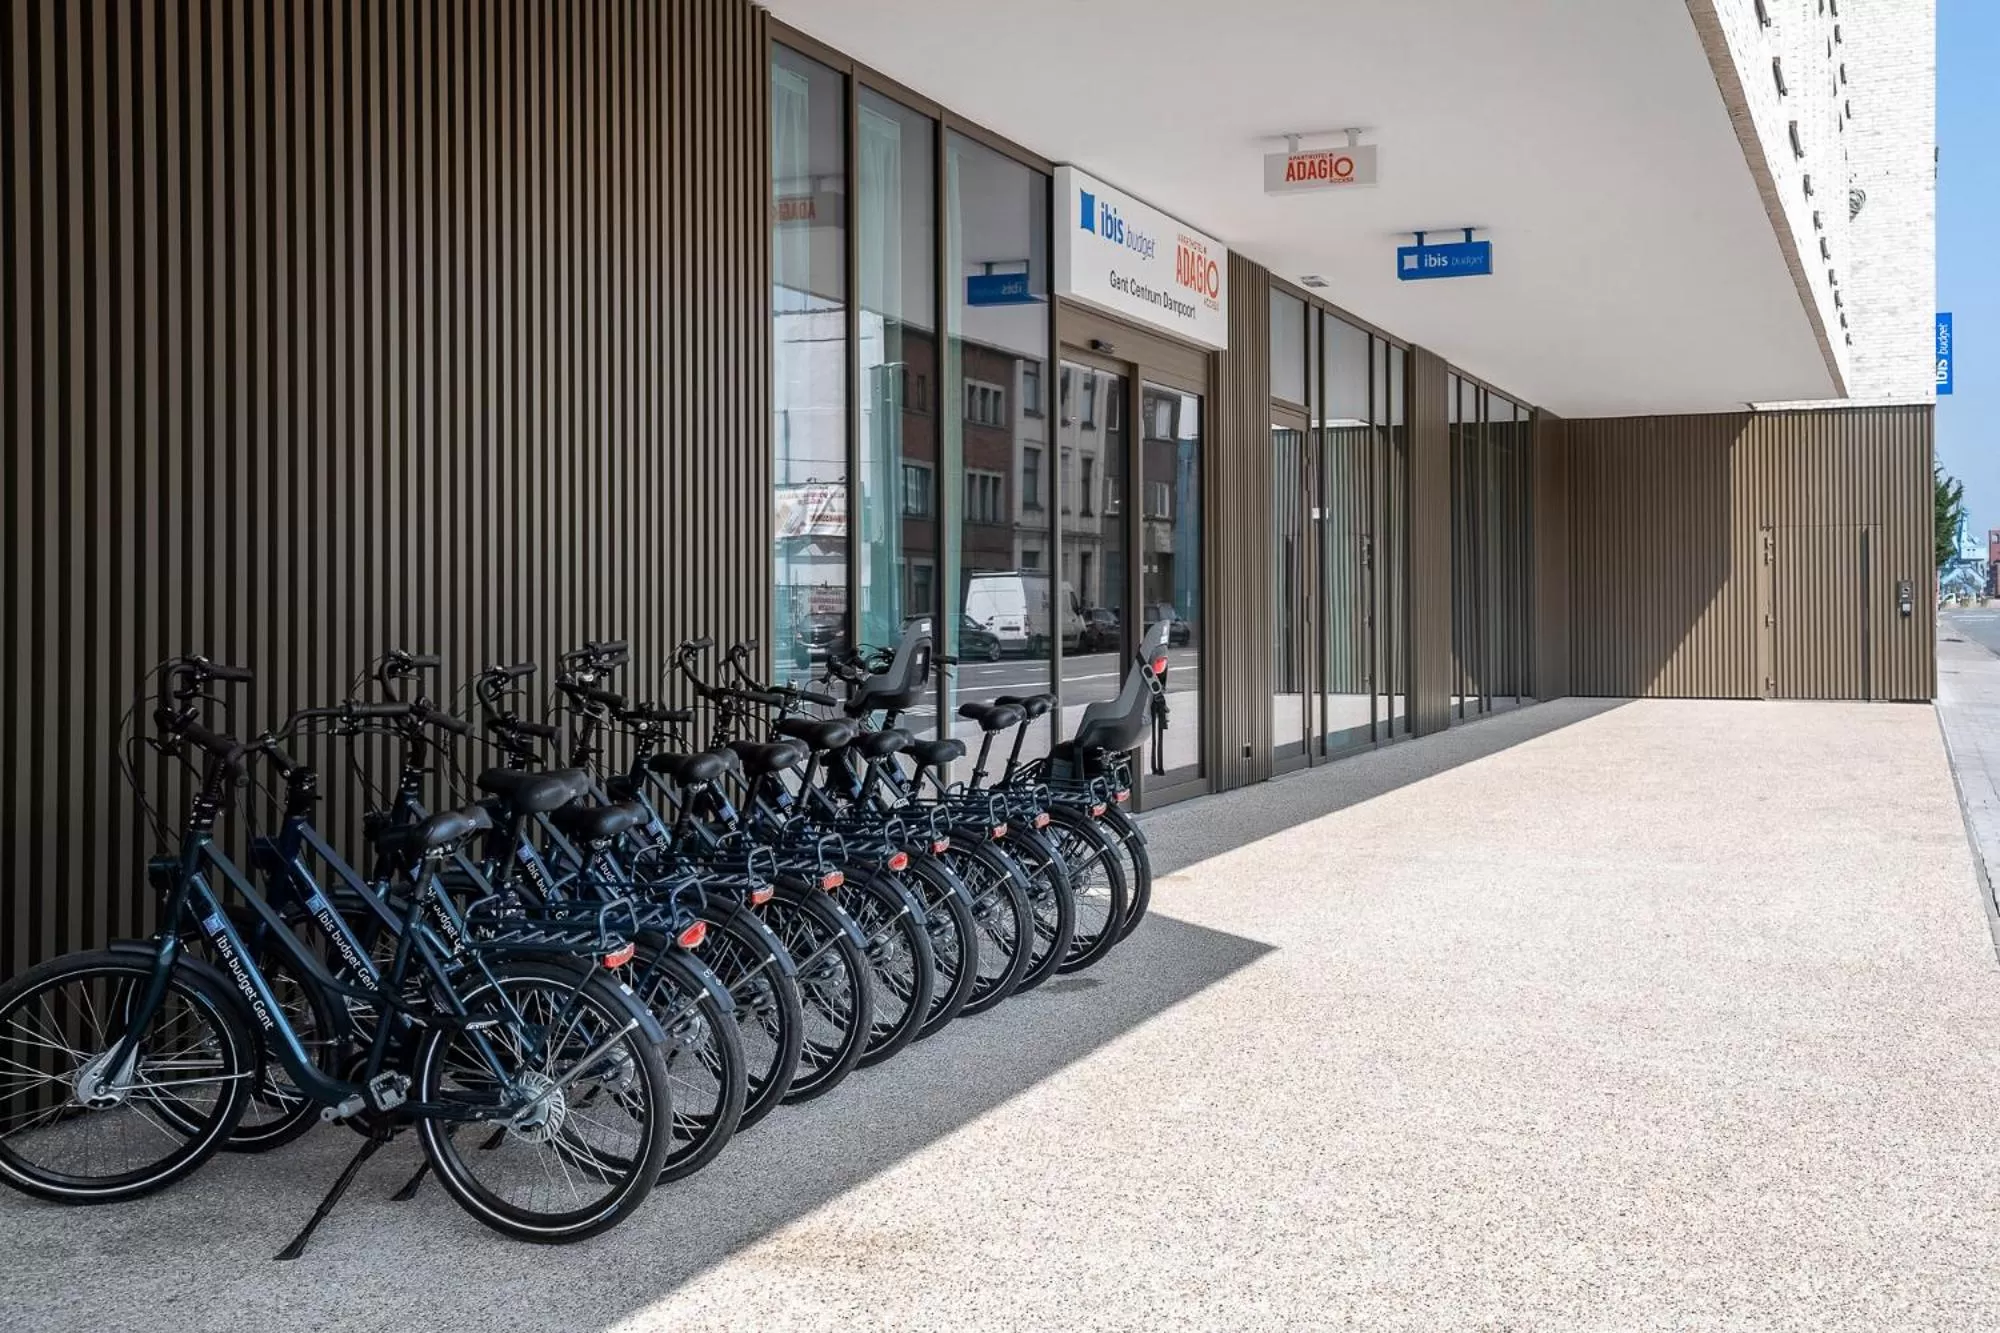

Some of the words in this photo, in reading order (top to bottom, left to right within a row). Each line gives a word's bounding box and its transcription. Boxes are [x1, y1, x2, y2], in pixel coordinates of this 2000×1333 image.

[1285, 153, 1354, 181] ADAGIO
[1100, 202, 1124, 244] ibis
[1126, 224, 1155, 260] budget
[1176, 244, 1219, 299] ADAGIO
[1424, 254, 1449, 267] ibis
[1110, 270, 1129, 293] Gent
[1130, 278, 1162, 307] Centrum
[1937, 322, 1951, 355] budget
[526, 861, 540, 880] ibis
[318, 911, 335, 932] ibis
[331, 929, 361, 970] budget
[216, 935, 233, 959] ibis
[228, 956, 257, 1001] budget
[252, 1000, 274, 1031] Gent
